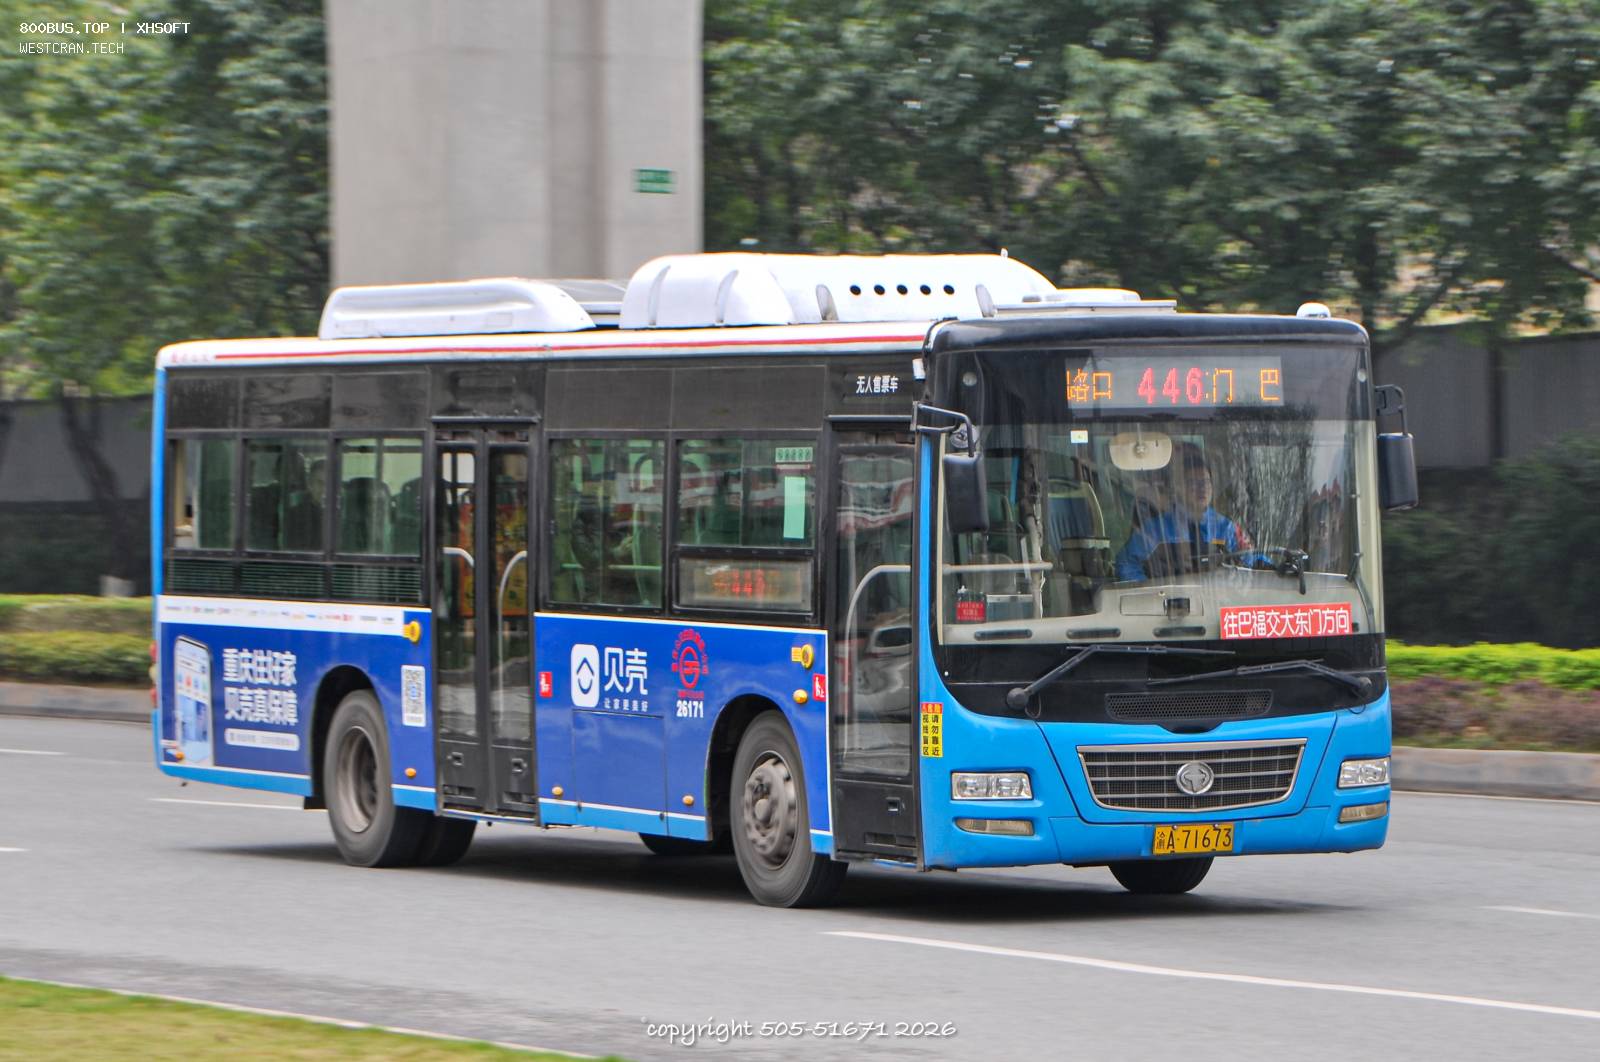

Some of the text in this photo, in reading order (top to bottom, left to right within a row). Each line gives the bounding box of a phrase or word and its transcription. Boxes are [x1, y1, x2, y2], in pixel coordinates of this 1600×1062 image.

[856, 375, 899, 394] 无人售票车
[1138, 367, 1203, 404] 446
[1260, 368, 1280, 401] 巴
[1223, 608, 1350, 638] 往巴福交大东门方向
[604, 646, 648, 695] 贝壳
[224, 687, 298, 726] 贝壳真保障
[676, 700, 704, 718] 26171
